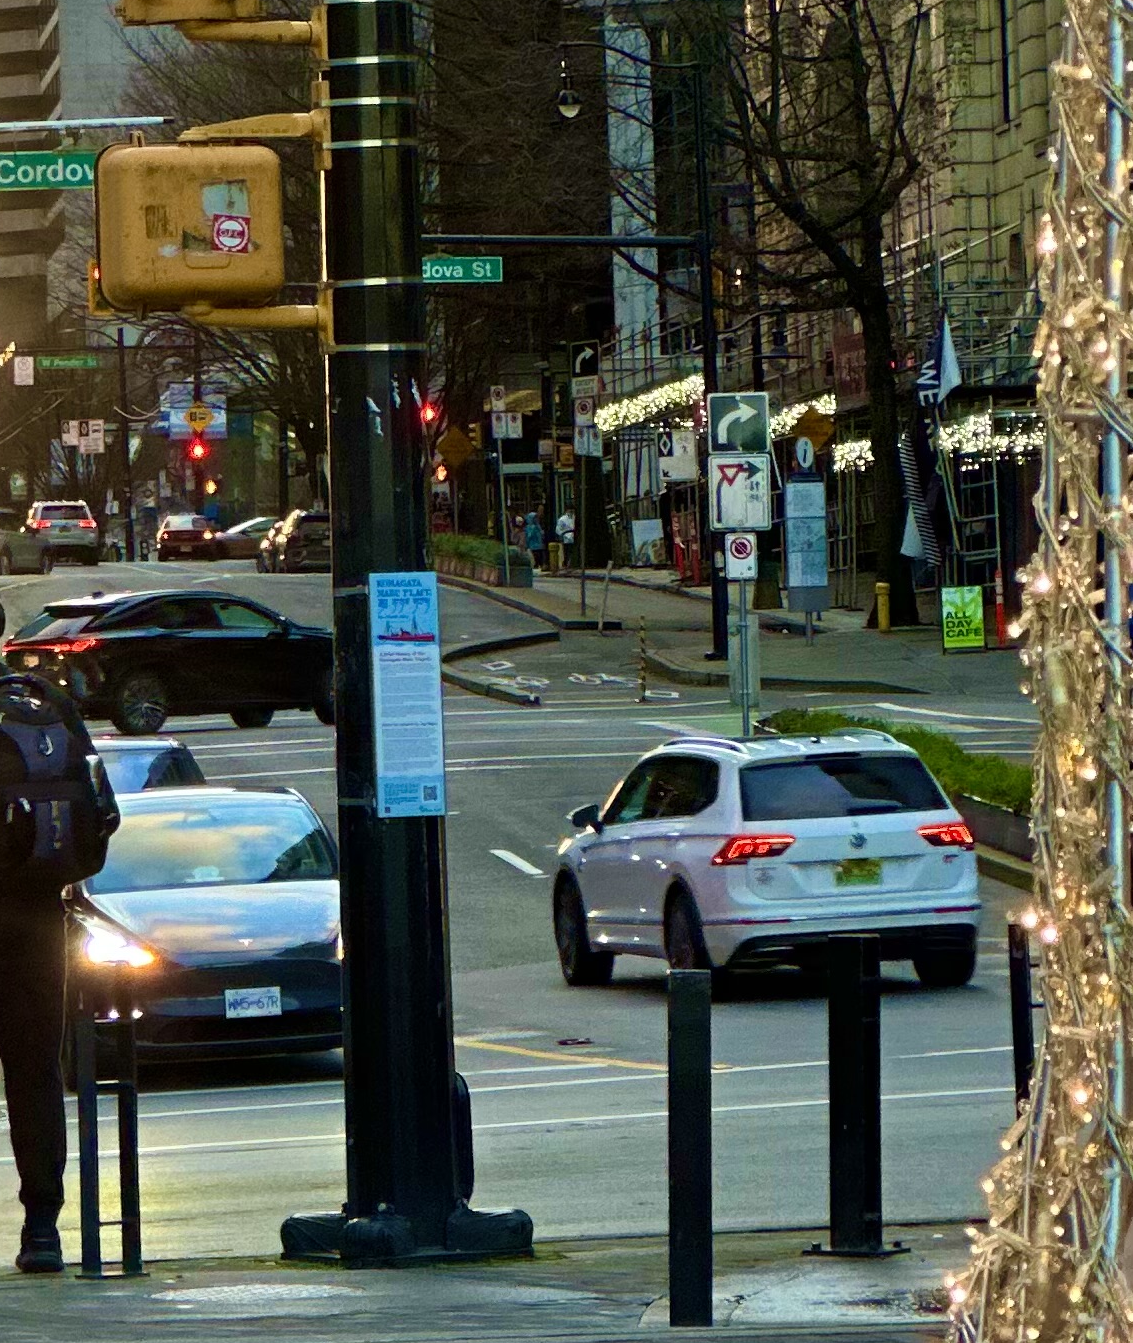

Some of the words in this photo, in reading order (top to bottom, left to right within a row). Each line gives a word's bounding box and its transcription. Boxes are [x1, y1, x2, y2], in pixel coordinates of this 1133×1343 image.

[422, 261, 463, 278] dova
[472, 261, 492, 278] St
[945, 611, 971, 620] ALL
[946, 619, 972, 629] DAY
